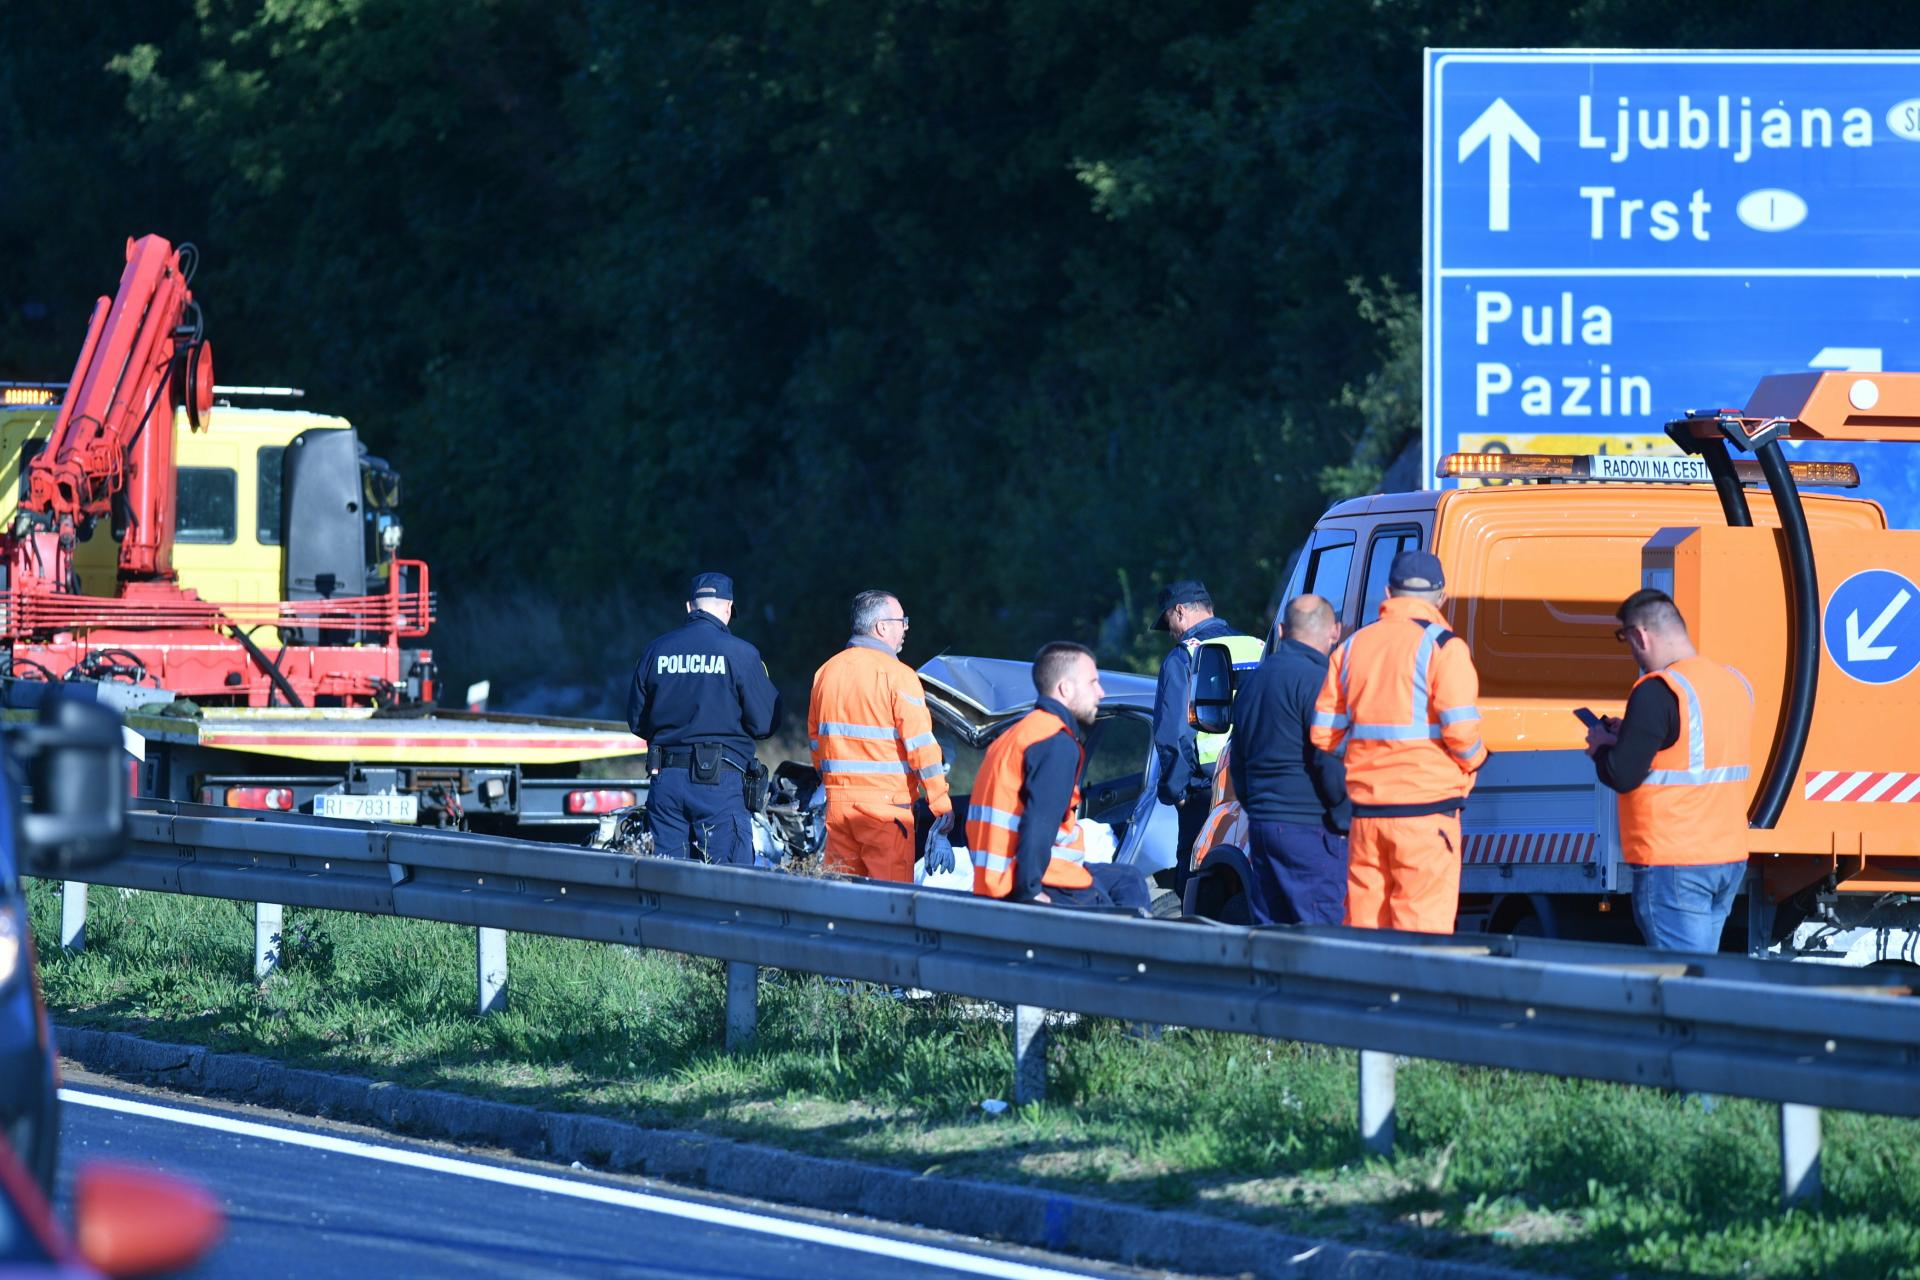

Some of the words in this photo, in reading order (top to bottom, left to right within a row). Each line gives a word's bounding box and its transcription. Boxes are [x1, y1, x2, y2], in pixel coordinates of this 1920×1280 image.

[1579, 95, 1873, 162] Ljubljana
[1579, 186, 1712, 241] Trst
[1476, 291, 1612, 345] Pula
[1476, 362, 1651, 416] Pazin
[1603, 459, 1650, 477] RADOVI
[1653, 460, 1670, 478] NA
[657, 654, 726, 675] POLICIJA
